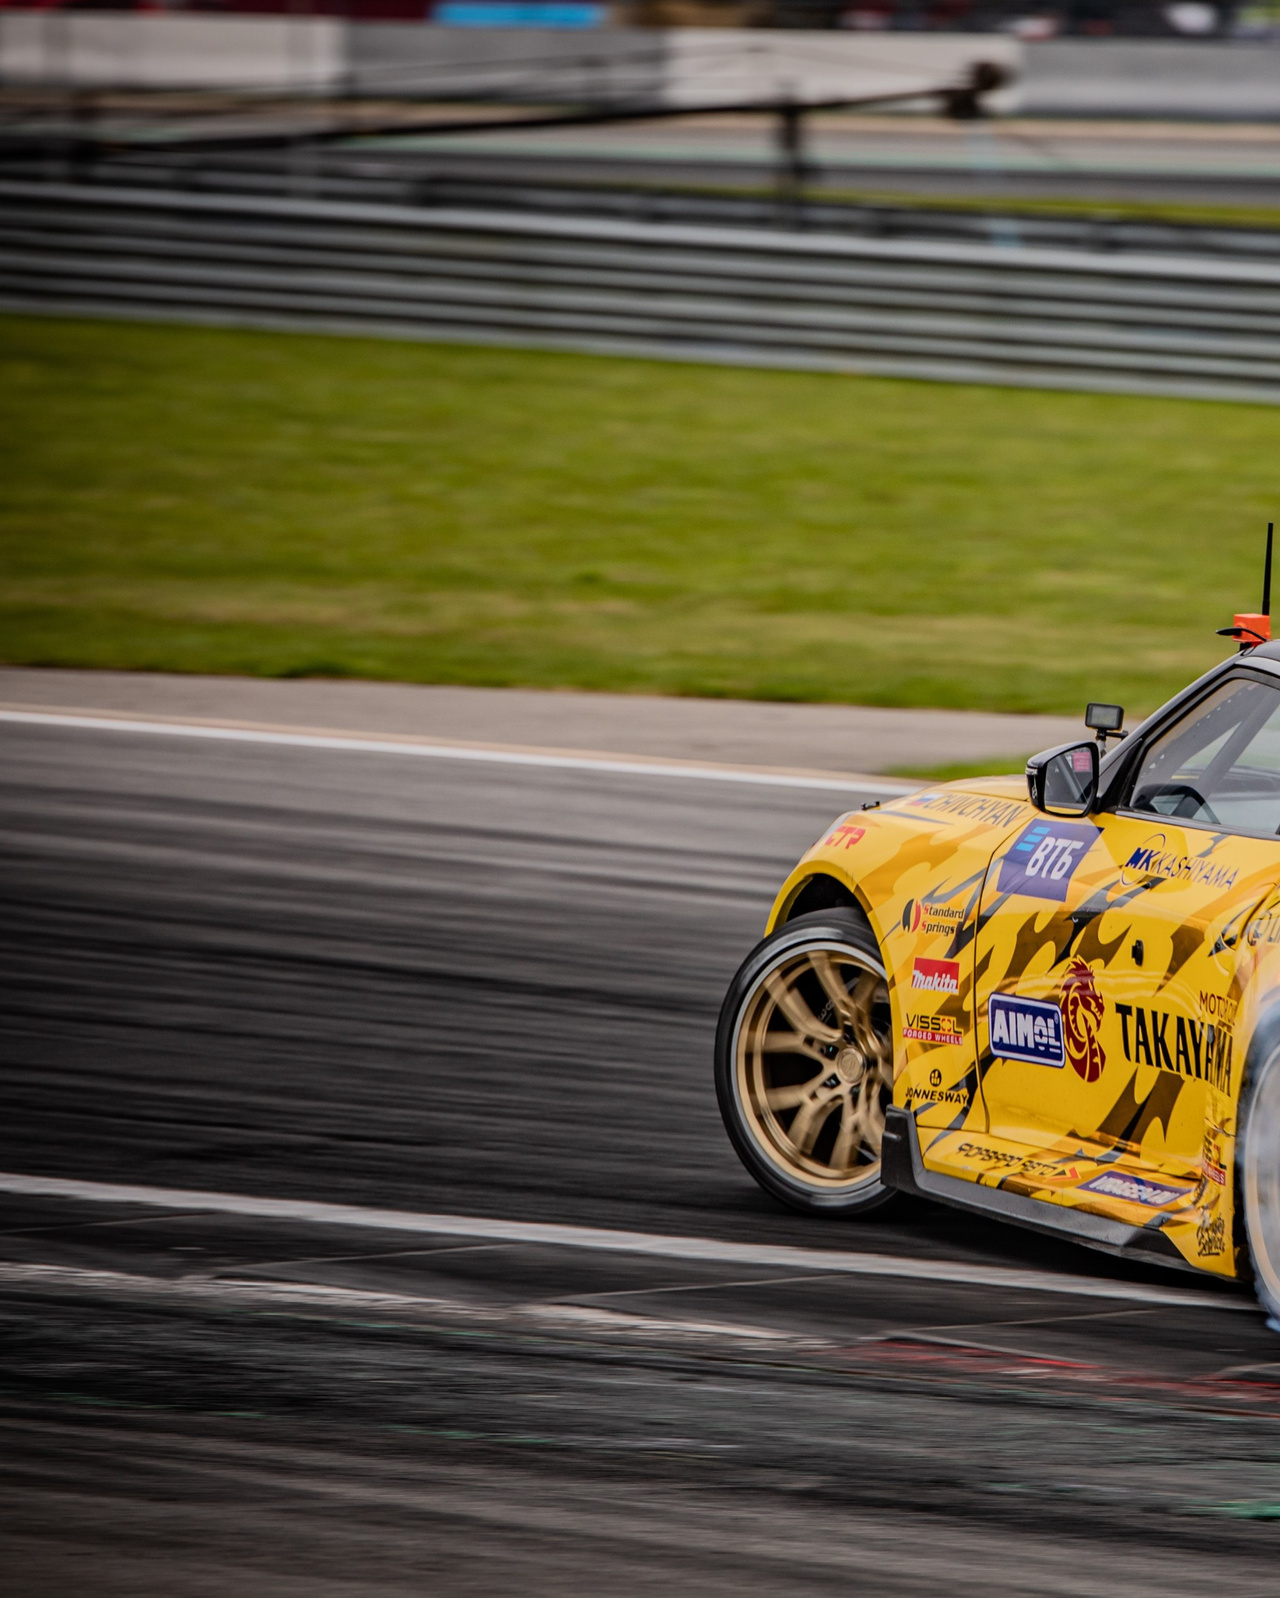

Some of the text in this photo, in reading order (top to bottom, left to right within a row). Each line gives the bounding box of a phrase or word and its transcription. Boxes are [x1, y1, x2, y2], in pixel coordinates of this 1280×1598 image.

[923, 794, 1028, 829] CHIVCHYAN
[1025, 836, 1084, 881] ВТБ
[923, 902, 964, 920] Standard
[921, 920, 955, 936] Springs
[905, 1013, 963, 1034] VISSOL
[992, 1009, 1061, 1053] AIMOL
[903, 1029, 963, 1045] FORGED WHEELS
[1115, 1002, 1234, 1098] TAKAYAMA
[905, 1087, 969, 1105] JONNESWAY
